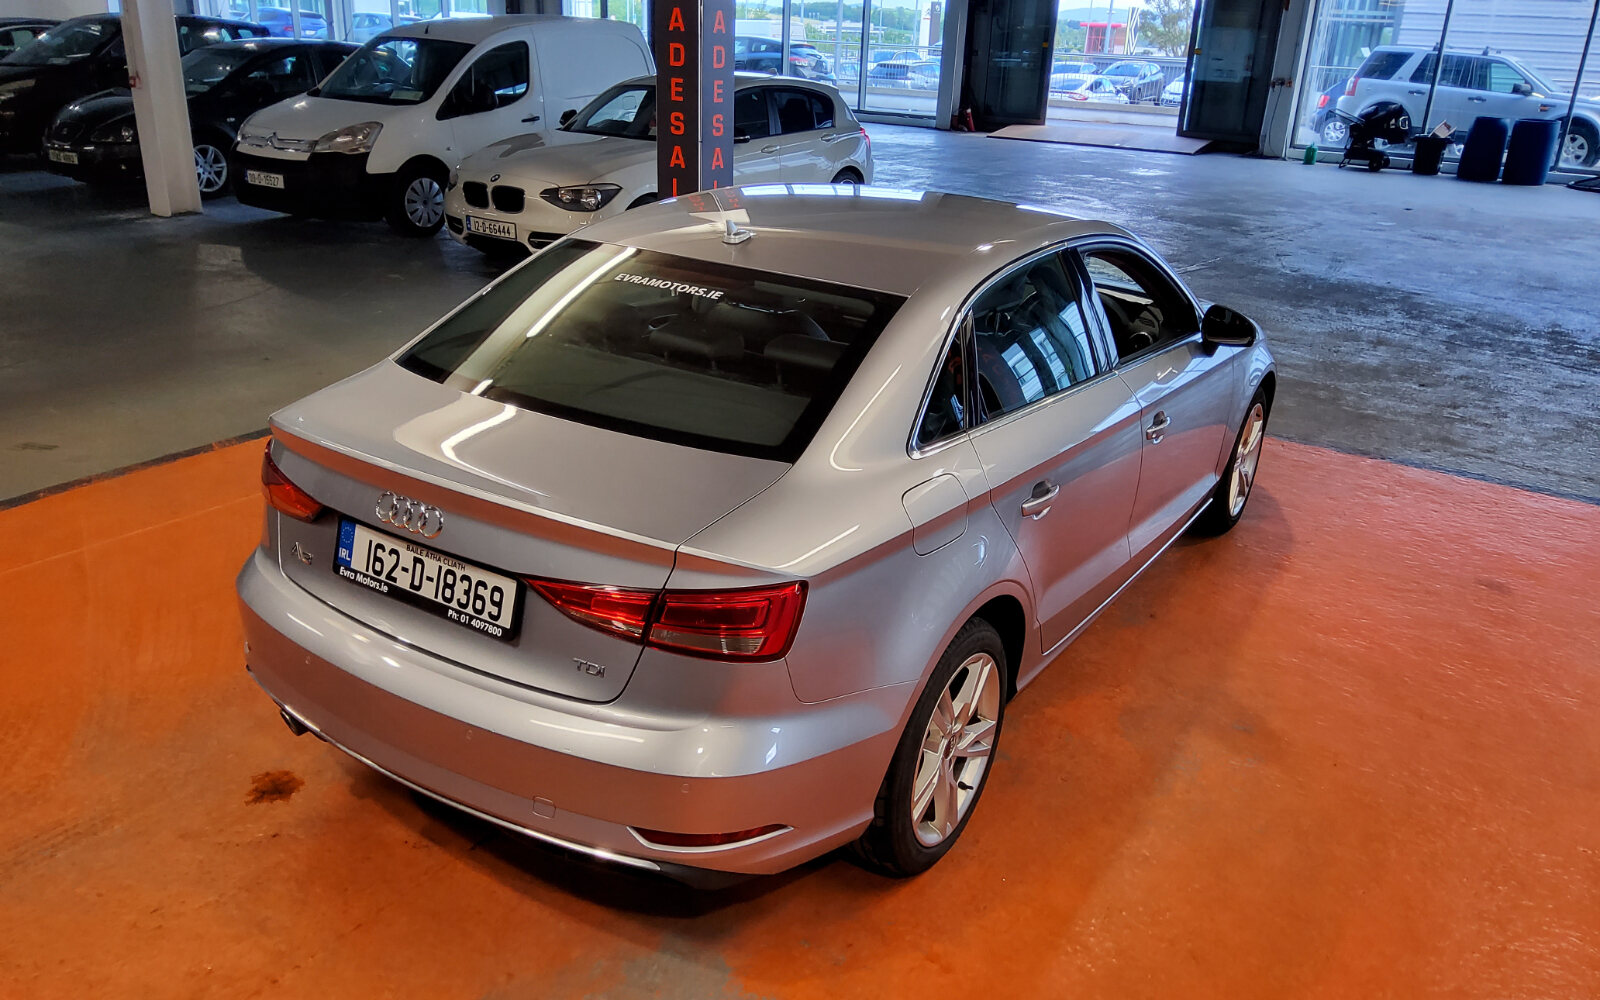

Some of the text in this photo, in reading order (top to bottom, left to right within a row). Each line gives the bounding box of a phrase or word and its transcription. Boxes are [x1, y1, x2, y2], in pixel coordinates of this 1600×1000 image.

[473, 220, 511, 236] 12-D-66444
[614, 273, 724, 300] EVRAMOTORS.IE
[338, 547, 351, 561] IRL
[406, 544, 424, 556] BAILE
[443, 558, 466, 572] CLIATH
[339, 566, 389, 593] Evra Motors.ie
[365, 539, 504, 622] 162-D-18369
[447, 609, 503, 637] Ph: 01 4097800
